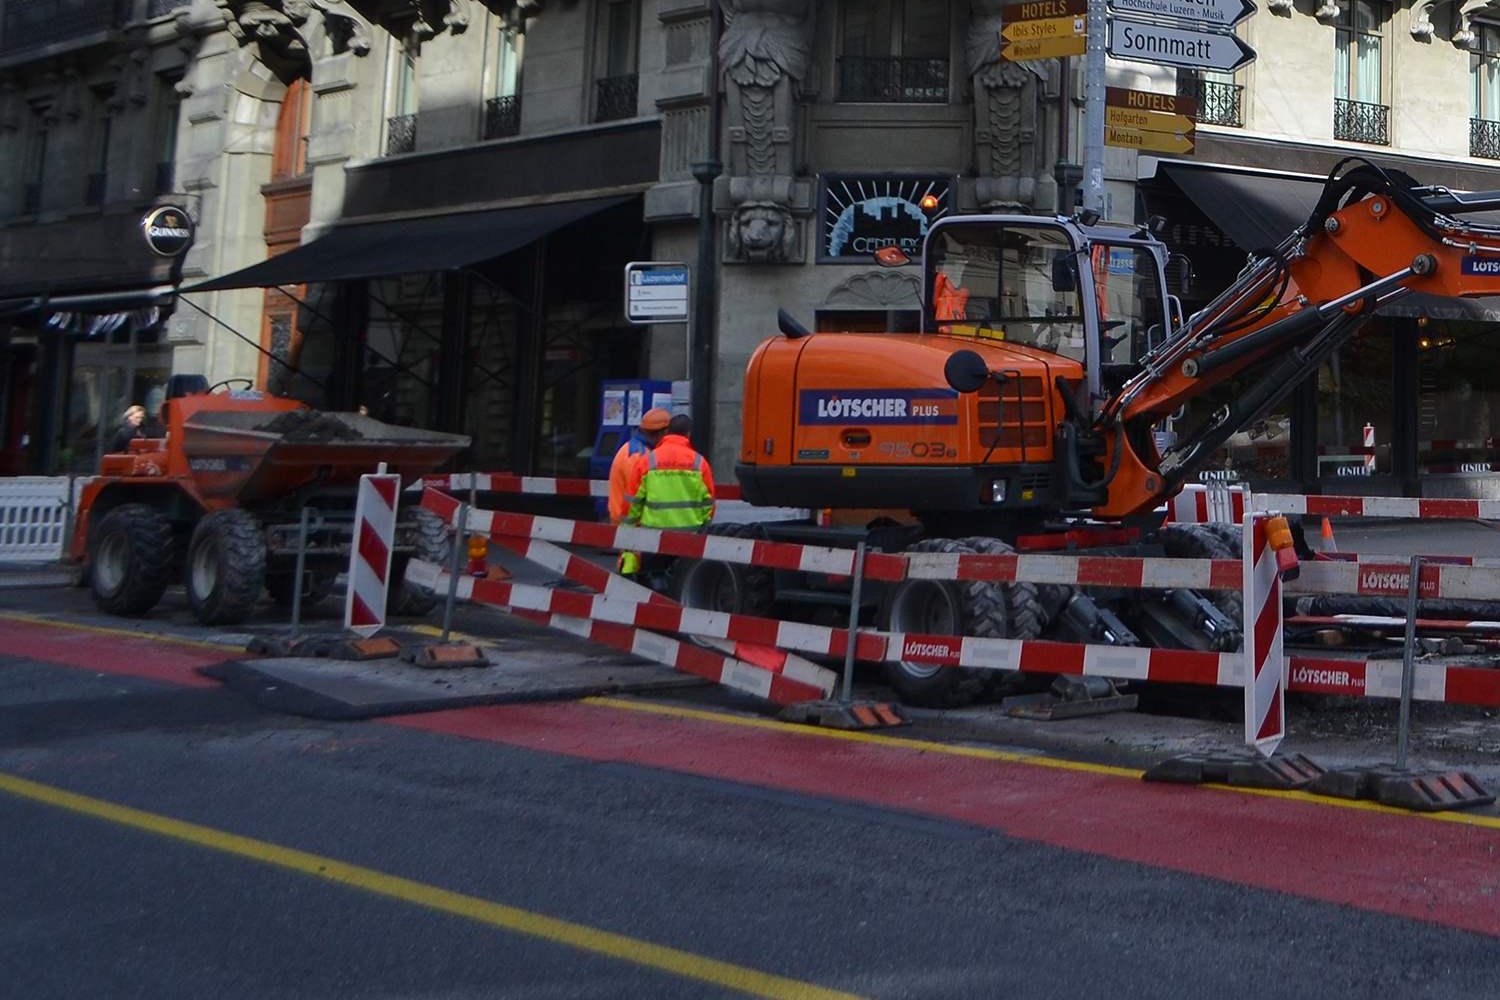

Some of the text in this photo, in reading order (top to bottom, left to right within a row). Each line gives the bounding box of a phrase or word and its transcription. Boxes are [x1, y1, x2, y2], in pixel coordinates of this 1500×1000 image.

[1021, 0, 1067, 19] HOTELS
[1169, 0, 1195, 16] Luzern
[1202, 6, 1226, 21] Musik
[1012, 22, 1057, 38] Ibis Styles
[1013, 43, 1041, 56] Weinhof
[1123, 26, 1212, 61] Sonnmatt
[1128, 90, 1176, 111] HOTELS
[1109, 109, 1148, 126] Hofgarten
[1109, 129, 1143, 145] Montana
[149, 225, 190, 237] GUINNESS
[817, 396, 940, 418] LÖTSCHER PLUS
[1362, 571, 1435, 590] LÖTSCHE PLUS
[905, 641, 949, 657] LÖTSCHER
[1293, 667, 1365, 687] LÖTSCHER PLUS
